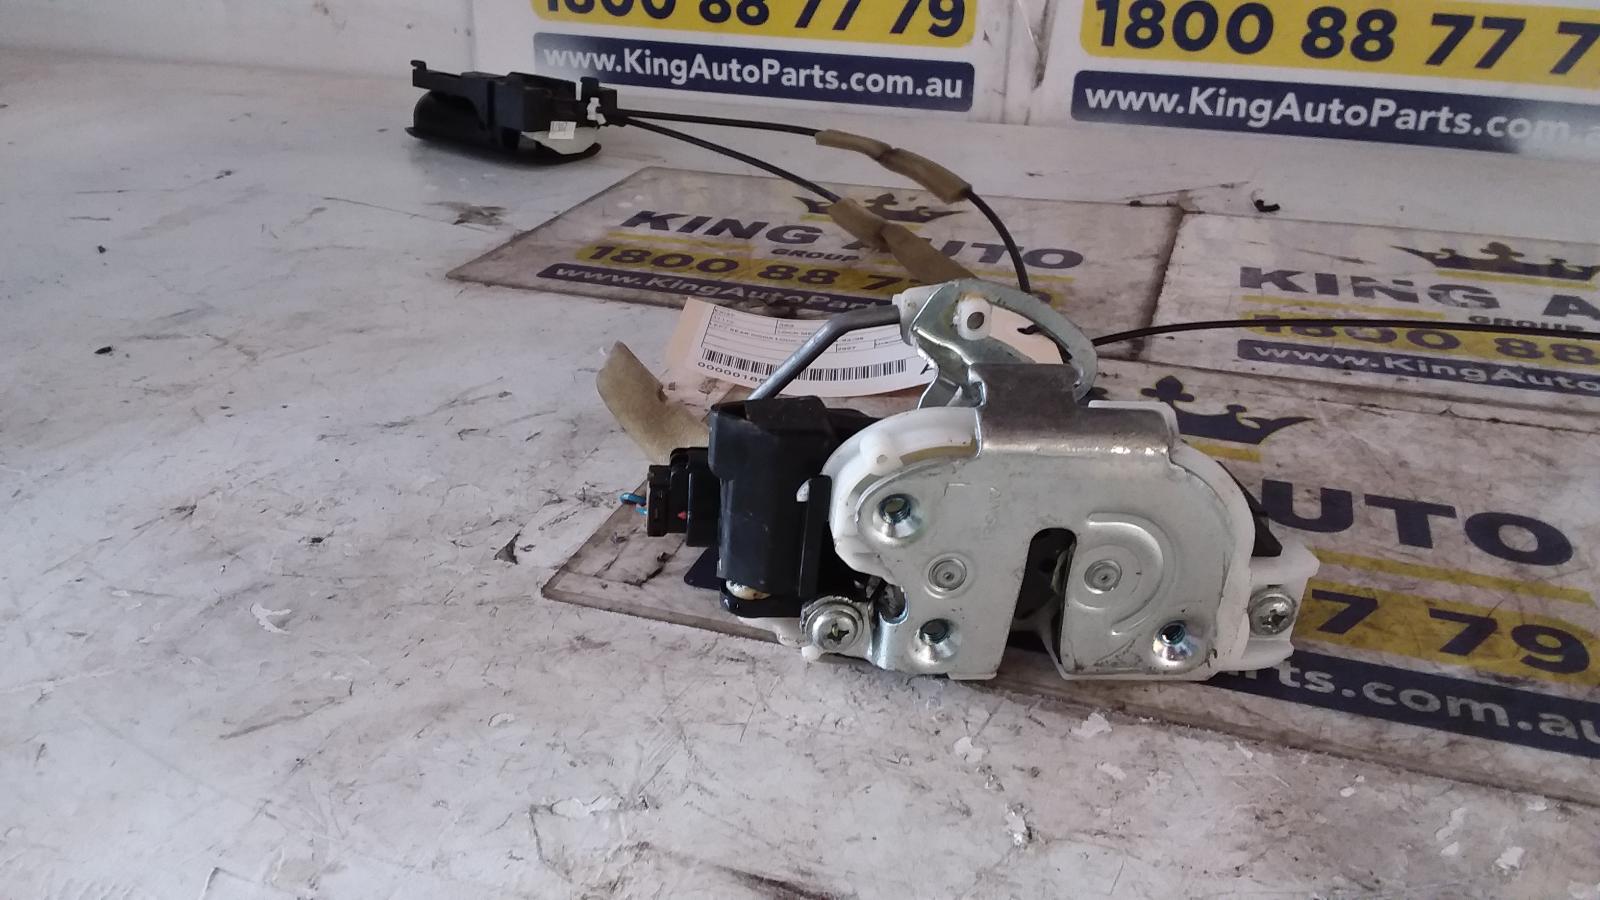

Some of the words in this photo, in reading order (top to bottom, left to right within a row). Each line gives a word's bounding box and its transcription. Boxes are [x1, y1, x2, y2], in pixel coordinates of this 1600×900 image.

[1096, 0, 1274, 55] 1800
[1301, 7, 1398, 61] 88
[1425, 13, 1526, 69] 77
[543, 48, 962, 99] www.KingAutoParts.com.au
[621, 210, 823, 245] KING
[589, 246, 739, 274] 1800
[757, 264, 841, 285] 88
[771, 248, 861, 263] GROUP
[1240, 266, 1500, 309] KING
[1494, 337, 1600, 365] 88
[1429, 607, 1590, 674] 79
[1228, 659, 1600, 746] ts.com.au
